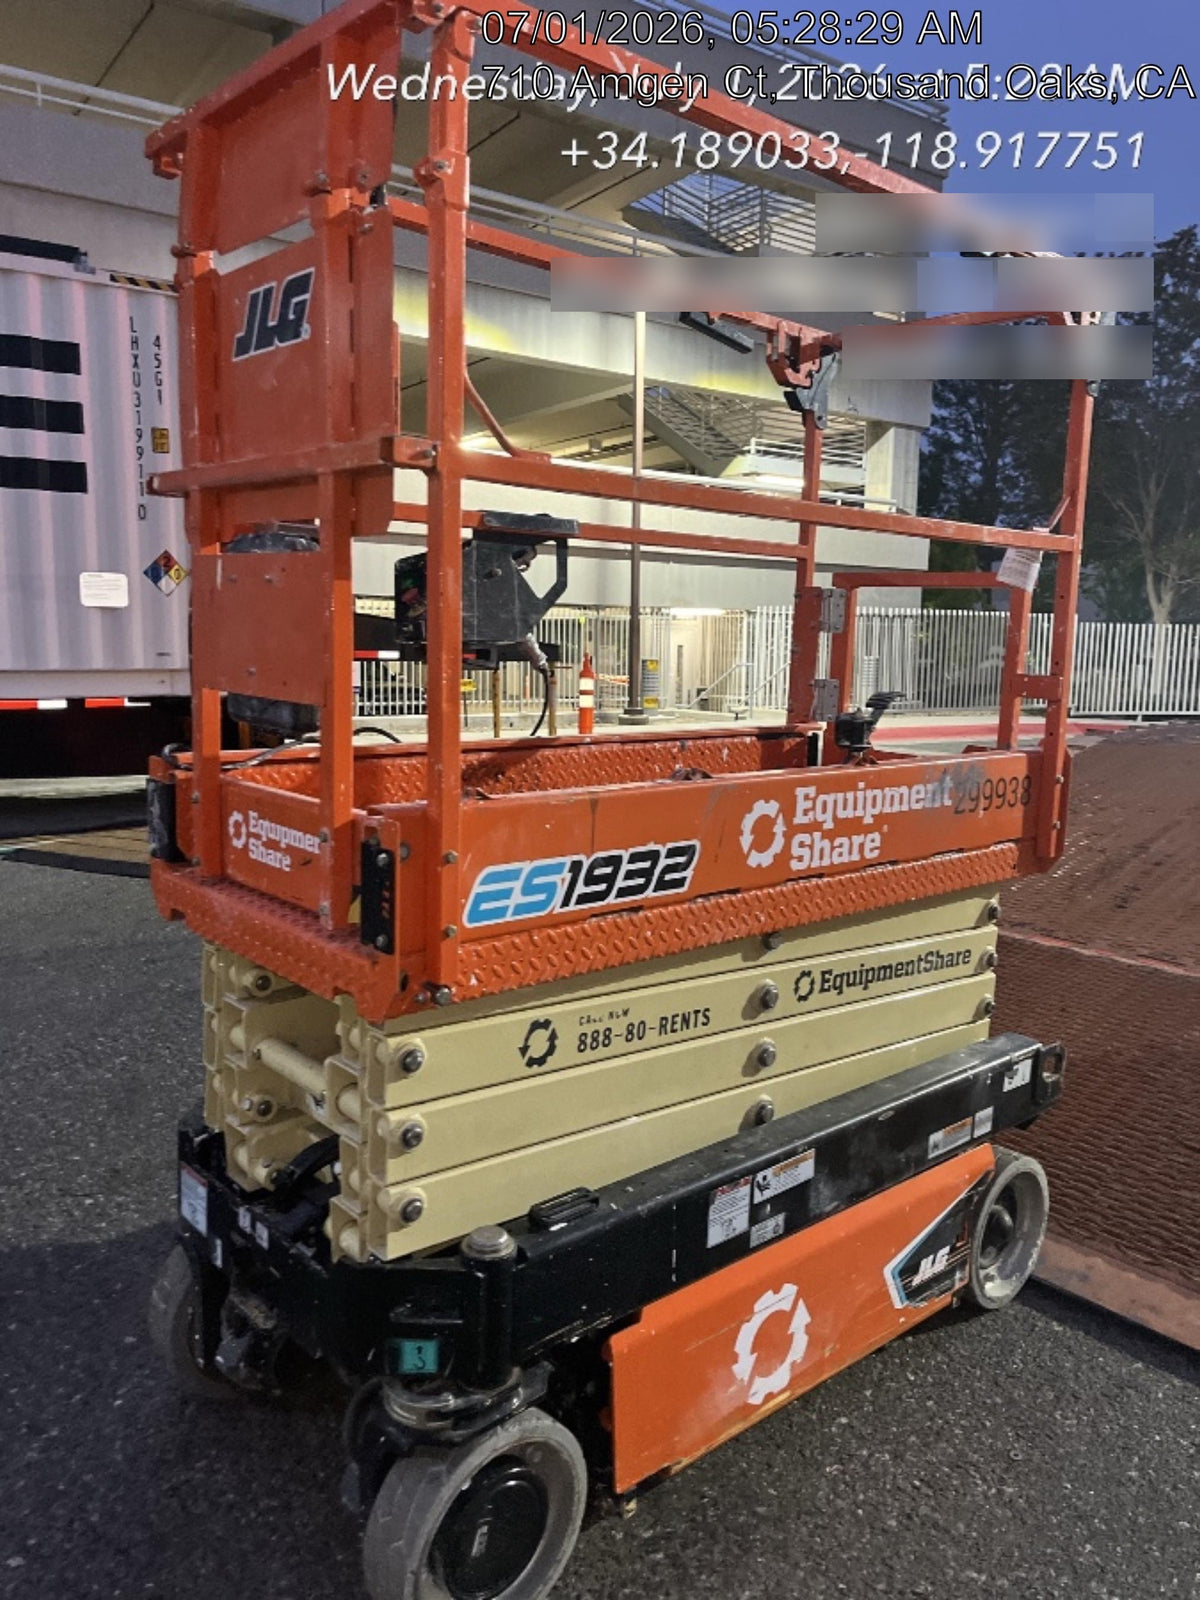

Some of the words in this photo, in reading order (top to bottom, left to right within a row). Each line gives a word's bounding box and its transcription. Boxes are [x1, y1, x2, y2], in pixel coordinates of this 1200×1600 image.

[231, 265, 315, 362] JLG
[793, 776, 953, 829] Equipment
[952, 774, 1032, 815] 299938
[249, 837, 292, 872] Share
[789, 831, 881, 871] Share
[464, 841, 699, 927] ES1932
[819, 949, 972, 996] EquipmentShare
[577, 1007, 711, 1053] 888-80-RENTS
[911, 1245, 951, 1286] JLG
